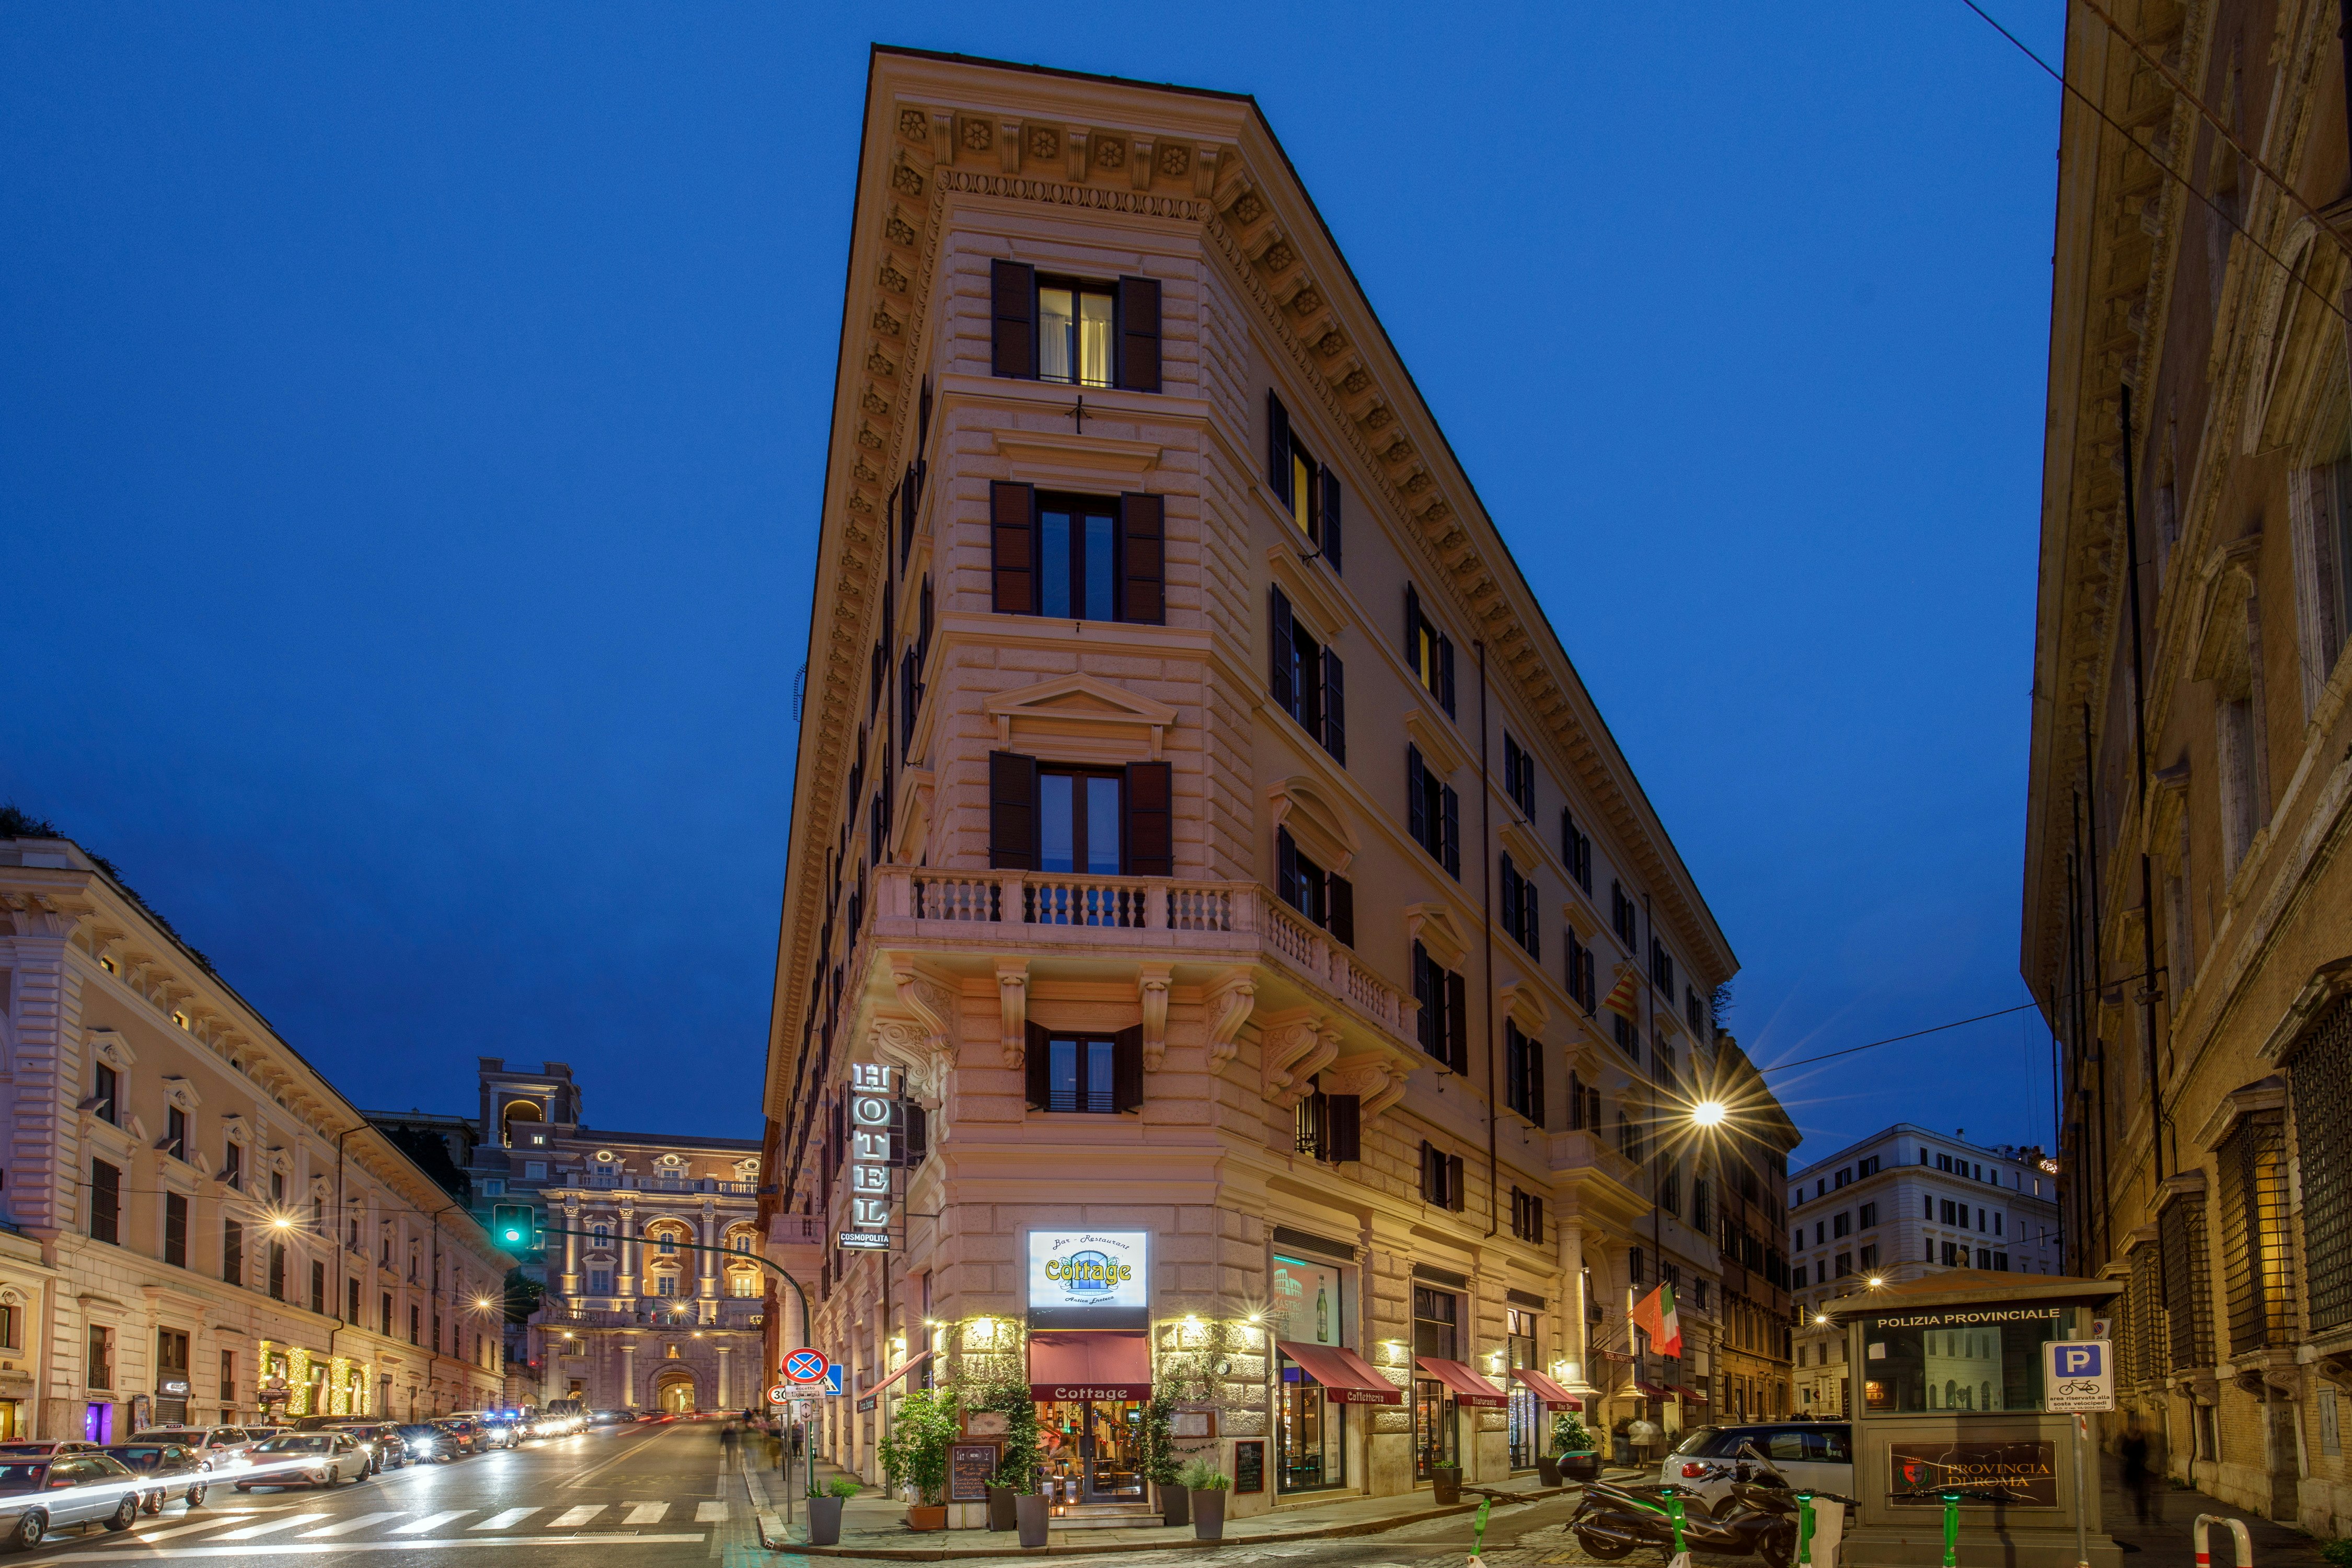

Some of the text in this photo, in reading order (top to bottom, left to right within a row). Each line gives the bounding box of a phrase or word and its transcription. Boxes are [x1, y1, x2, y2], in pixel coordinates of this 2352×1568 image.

[853, 1064, 889, 1225] HOTEL
[840, 1233, 889, 1242] COSMOPOLITA
[1052, 1239, 1070, 1250] Bar
[1080, 1235, 1130, 1250] Restaurant
[1045, 1260, 1131, 1285] Cottage
[1089, 1296, 1114, 1305] Enoteca
[1275, 1297, 1302, 1311] NASTRO
[1877, 1308, 2060, 1328] POLIZIA PROVINCIALE
[2066, 1350, 2090, 1373] P
[1055, 1388, 1127, 1401] Cottage
[1347, 1391, 1384, 1402] Caffetteria
[1472, 1397, 1497, 1406] Ristorante
[1947, 1463, 2050, 1474] PROVINCIA
[1947, 1477, 2030, 1486] DI ROMA
